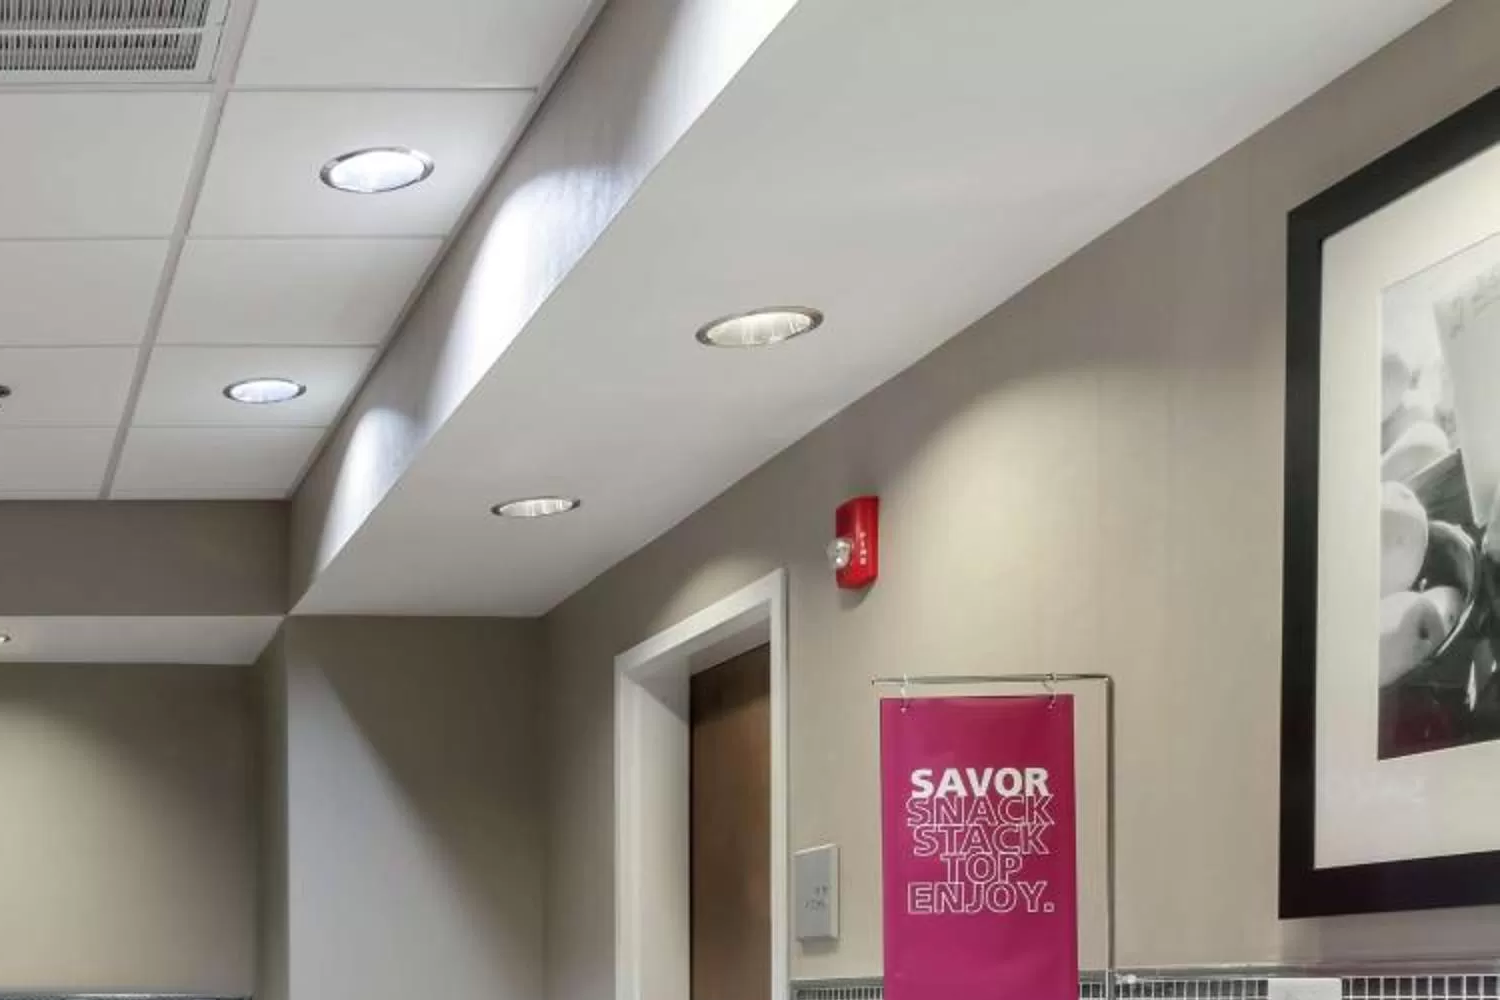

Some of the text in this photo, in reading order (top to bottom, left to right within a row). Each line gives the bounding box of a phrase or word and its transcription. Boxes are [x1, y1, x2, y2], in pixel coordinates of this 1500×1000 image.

[910, 767, 1050, 798] SAVOR
[905, 793, 1055, 827] SNACK
[912, 822, 1050, 857] STACK
[939, 851, 1023, 885] TOP
[906, 880, 1056, 915] ENJOY.
